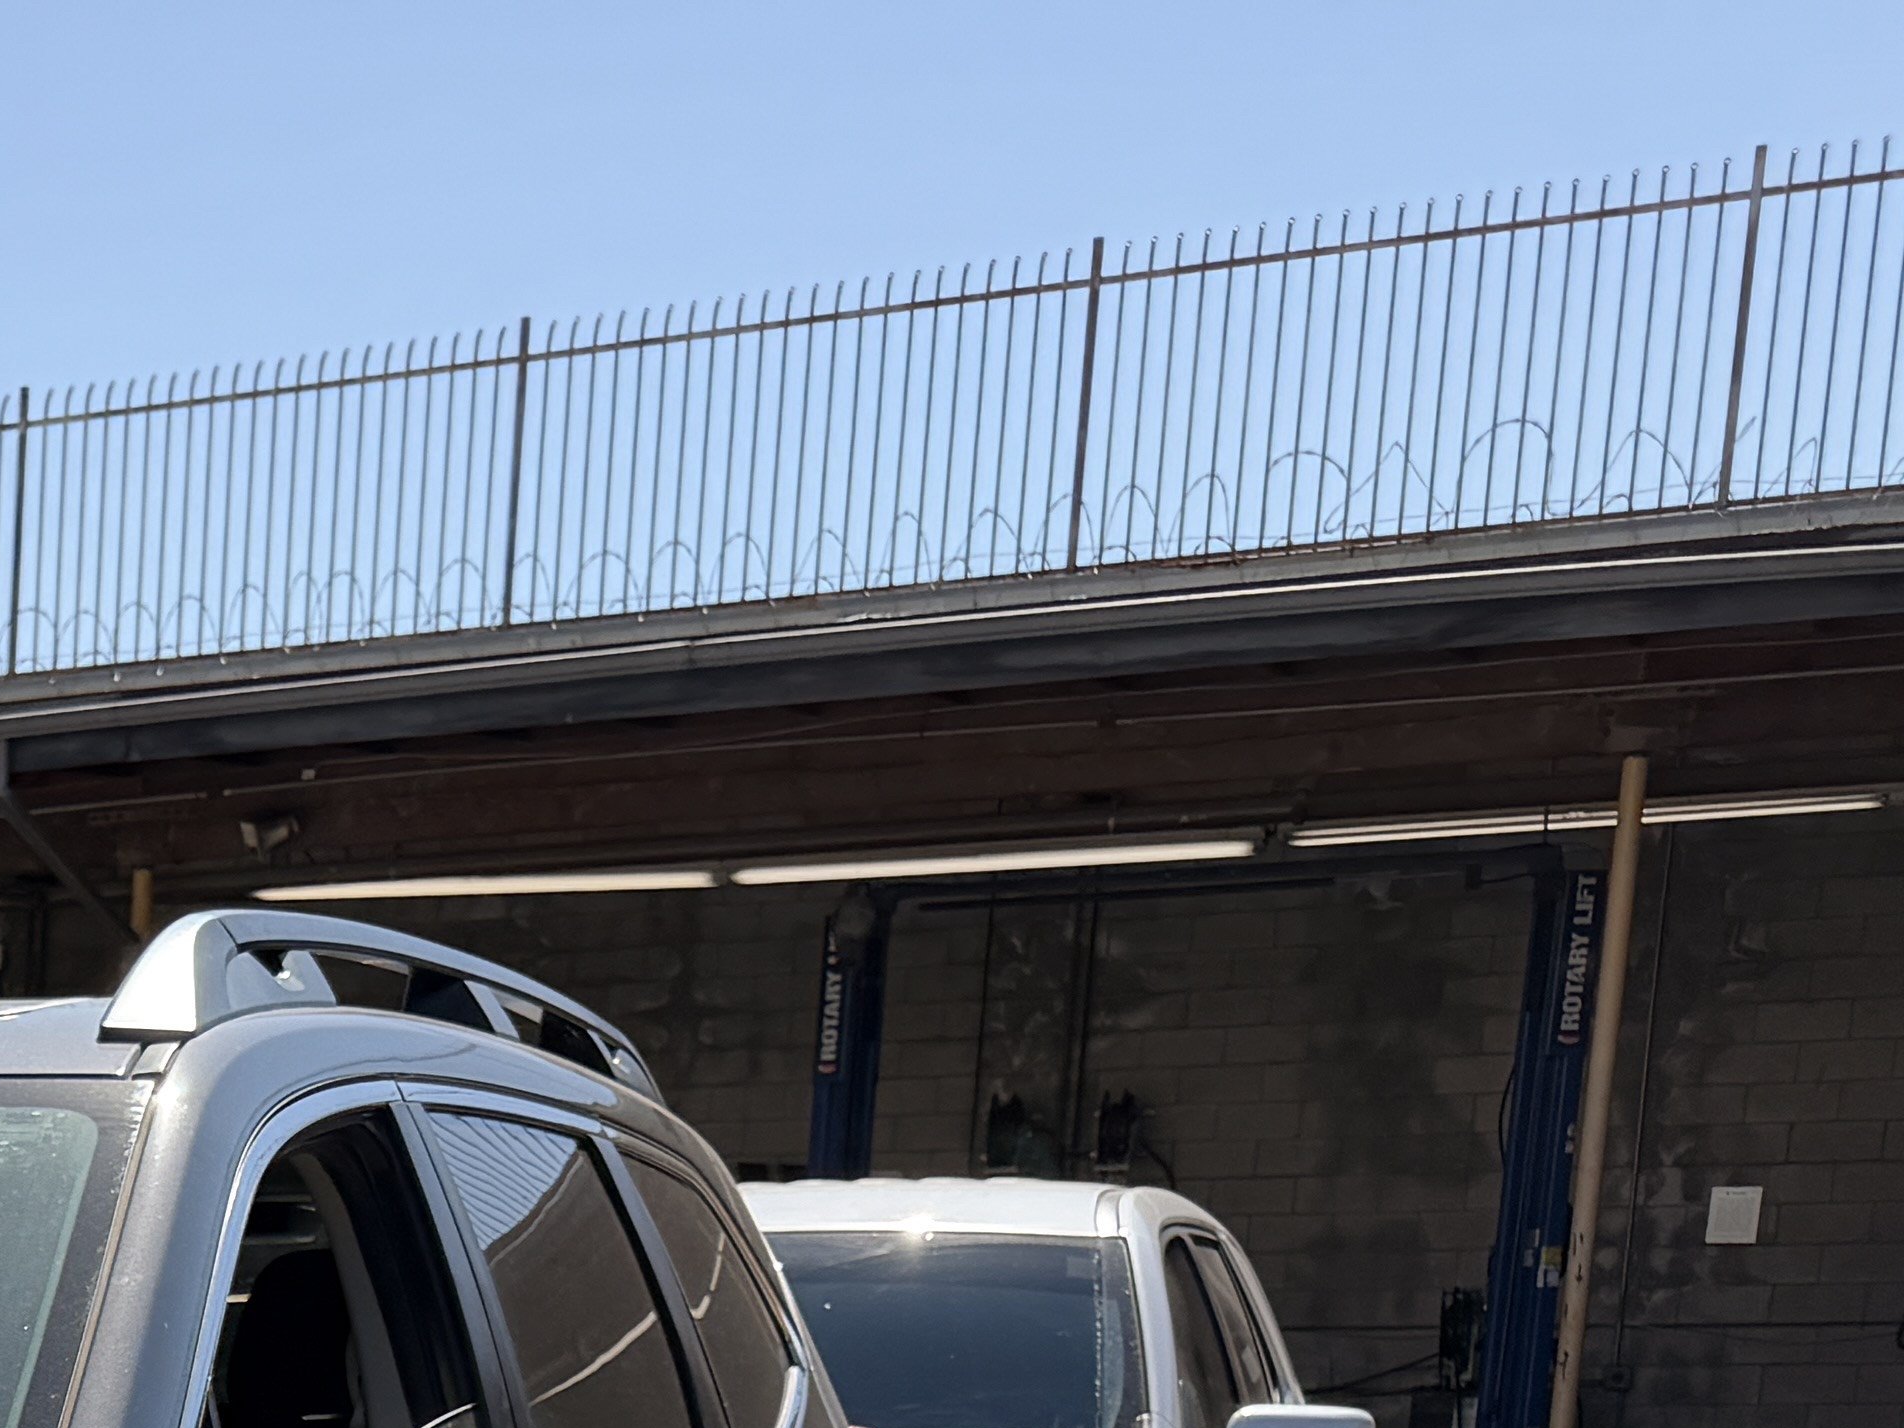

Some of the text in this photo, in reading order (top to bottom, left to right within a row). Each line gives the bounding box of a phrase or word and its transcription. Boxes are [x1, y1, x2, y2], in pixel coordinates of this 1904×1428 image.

[819, 969, 843, 1061] ROTARY
[1560, 873, 1598, 1032] ROTARY LIFT
